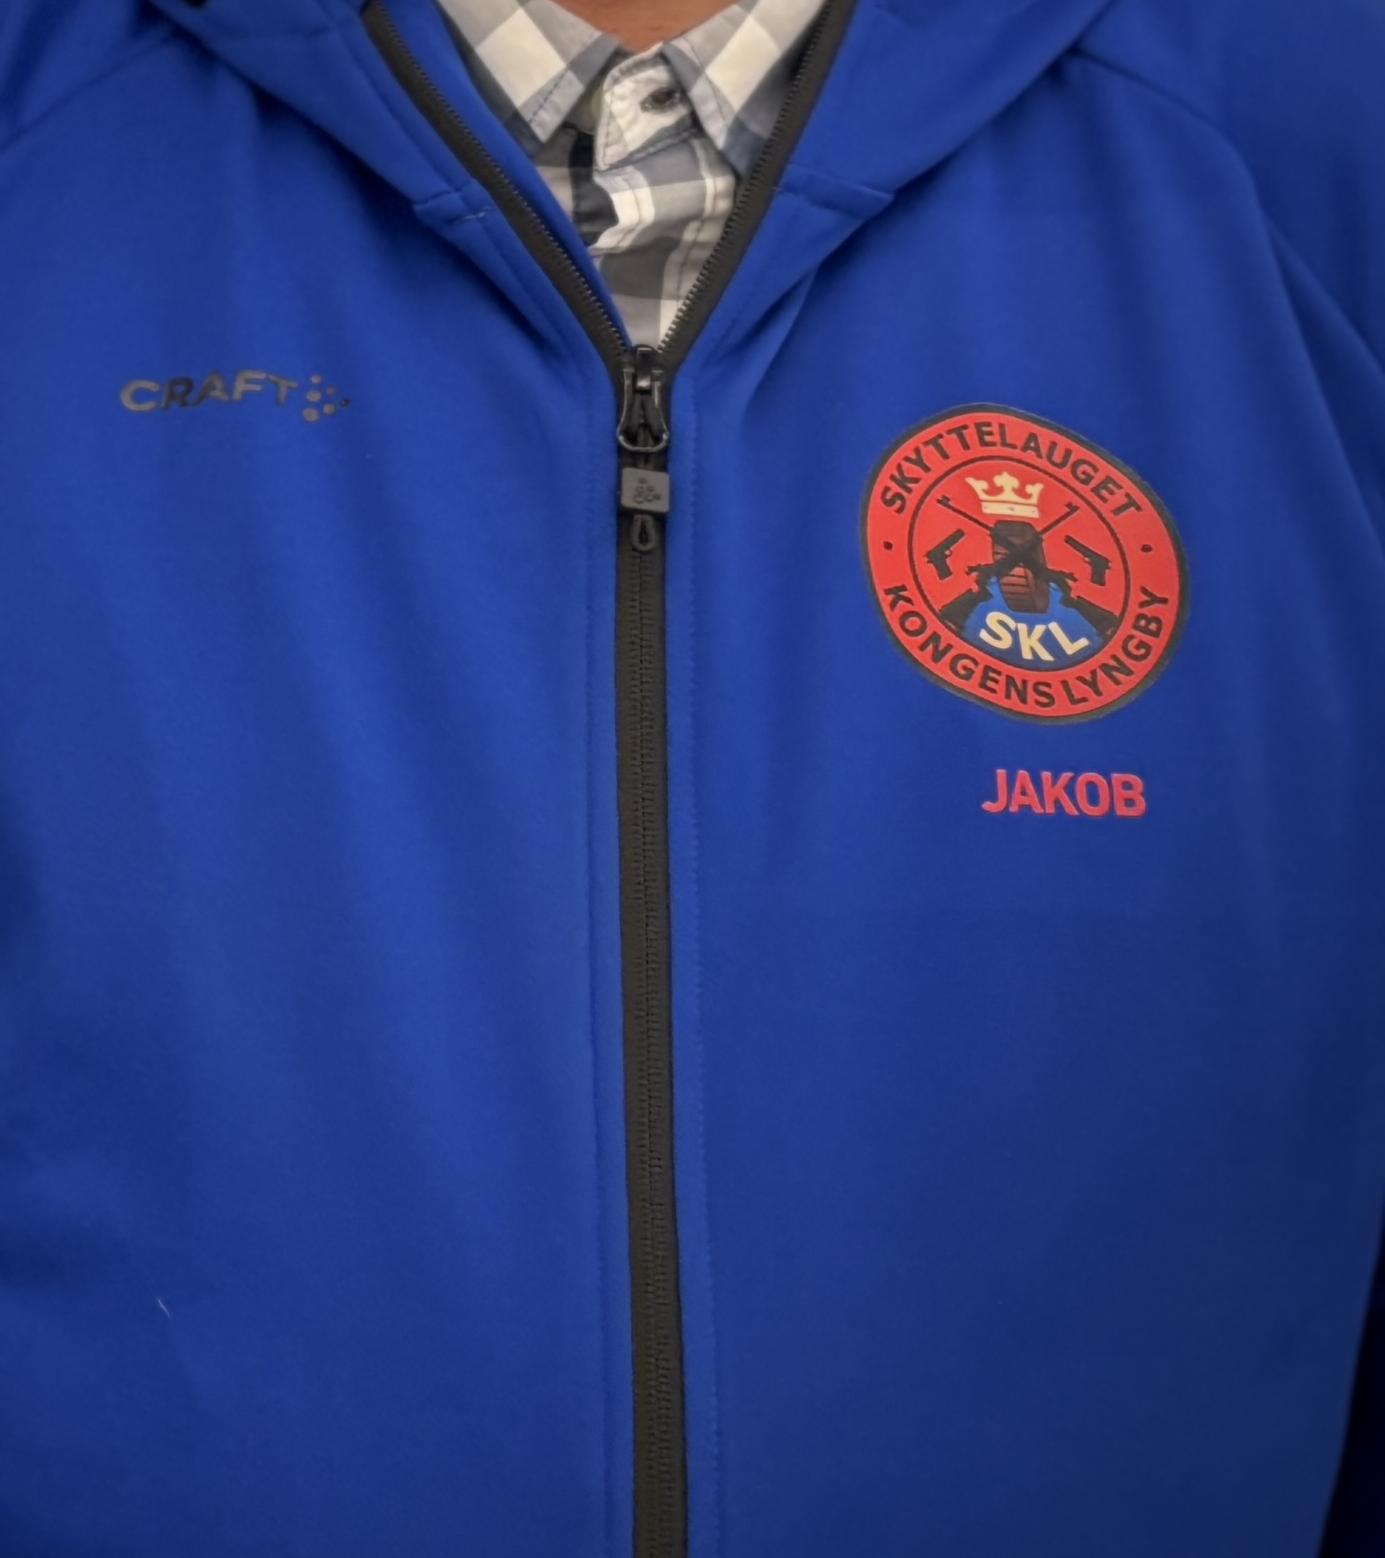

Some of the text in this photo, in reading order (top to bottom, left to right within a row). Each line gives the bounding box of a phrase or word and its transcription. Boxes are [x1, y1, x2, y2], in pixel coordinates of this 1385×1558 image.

[120, 369, 298, 412] CRAFT
[881, 421, 1144, 518] SKYTTELAUGET
[883, 583, 1169, 709] KONGENS LYNGBY
[979, 611, 1089, 662] SKL
[982, 769, 1146, 817] JAKOB
